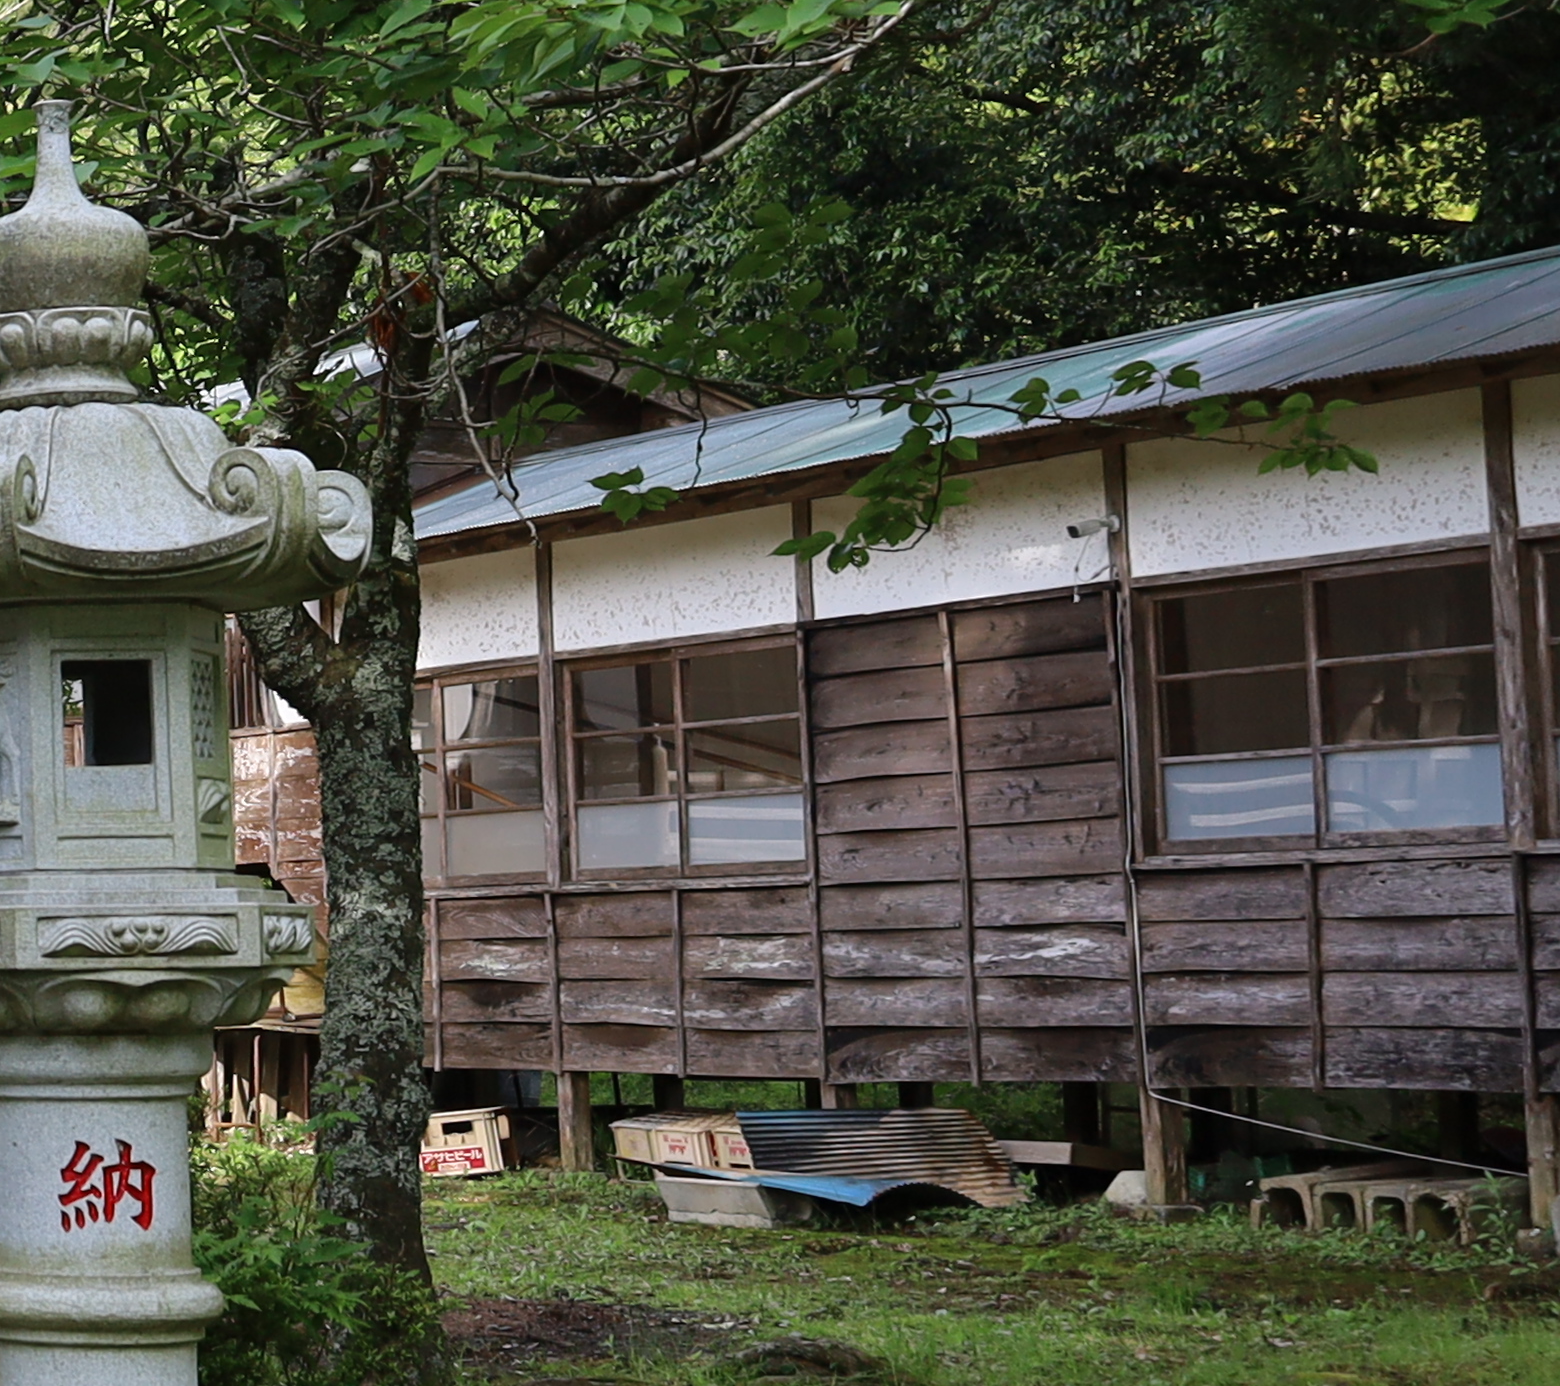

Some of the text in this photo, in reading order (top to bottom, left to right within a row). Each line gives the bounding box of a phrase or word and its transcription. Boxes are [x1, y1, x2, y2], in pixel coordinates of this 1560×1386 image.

[422, 1149, 482, 1164] アサヒビール
[58, 1138, 156, 1233] 納
